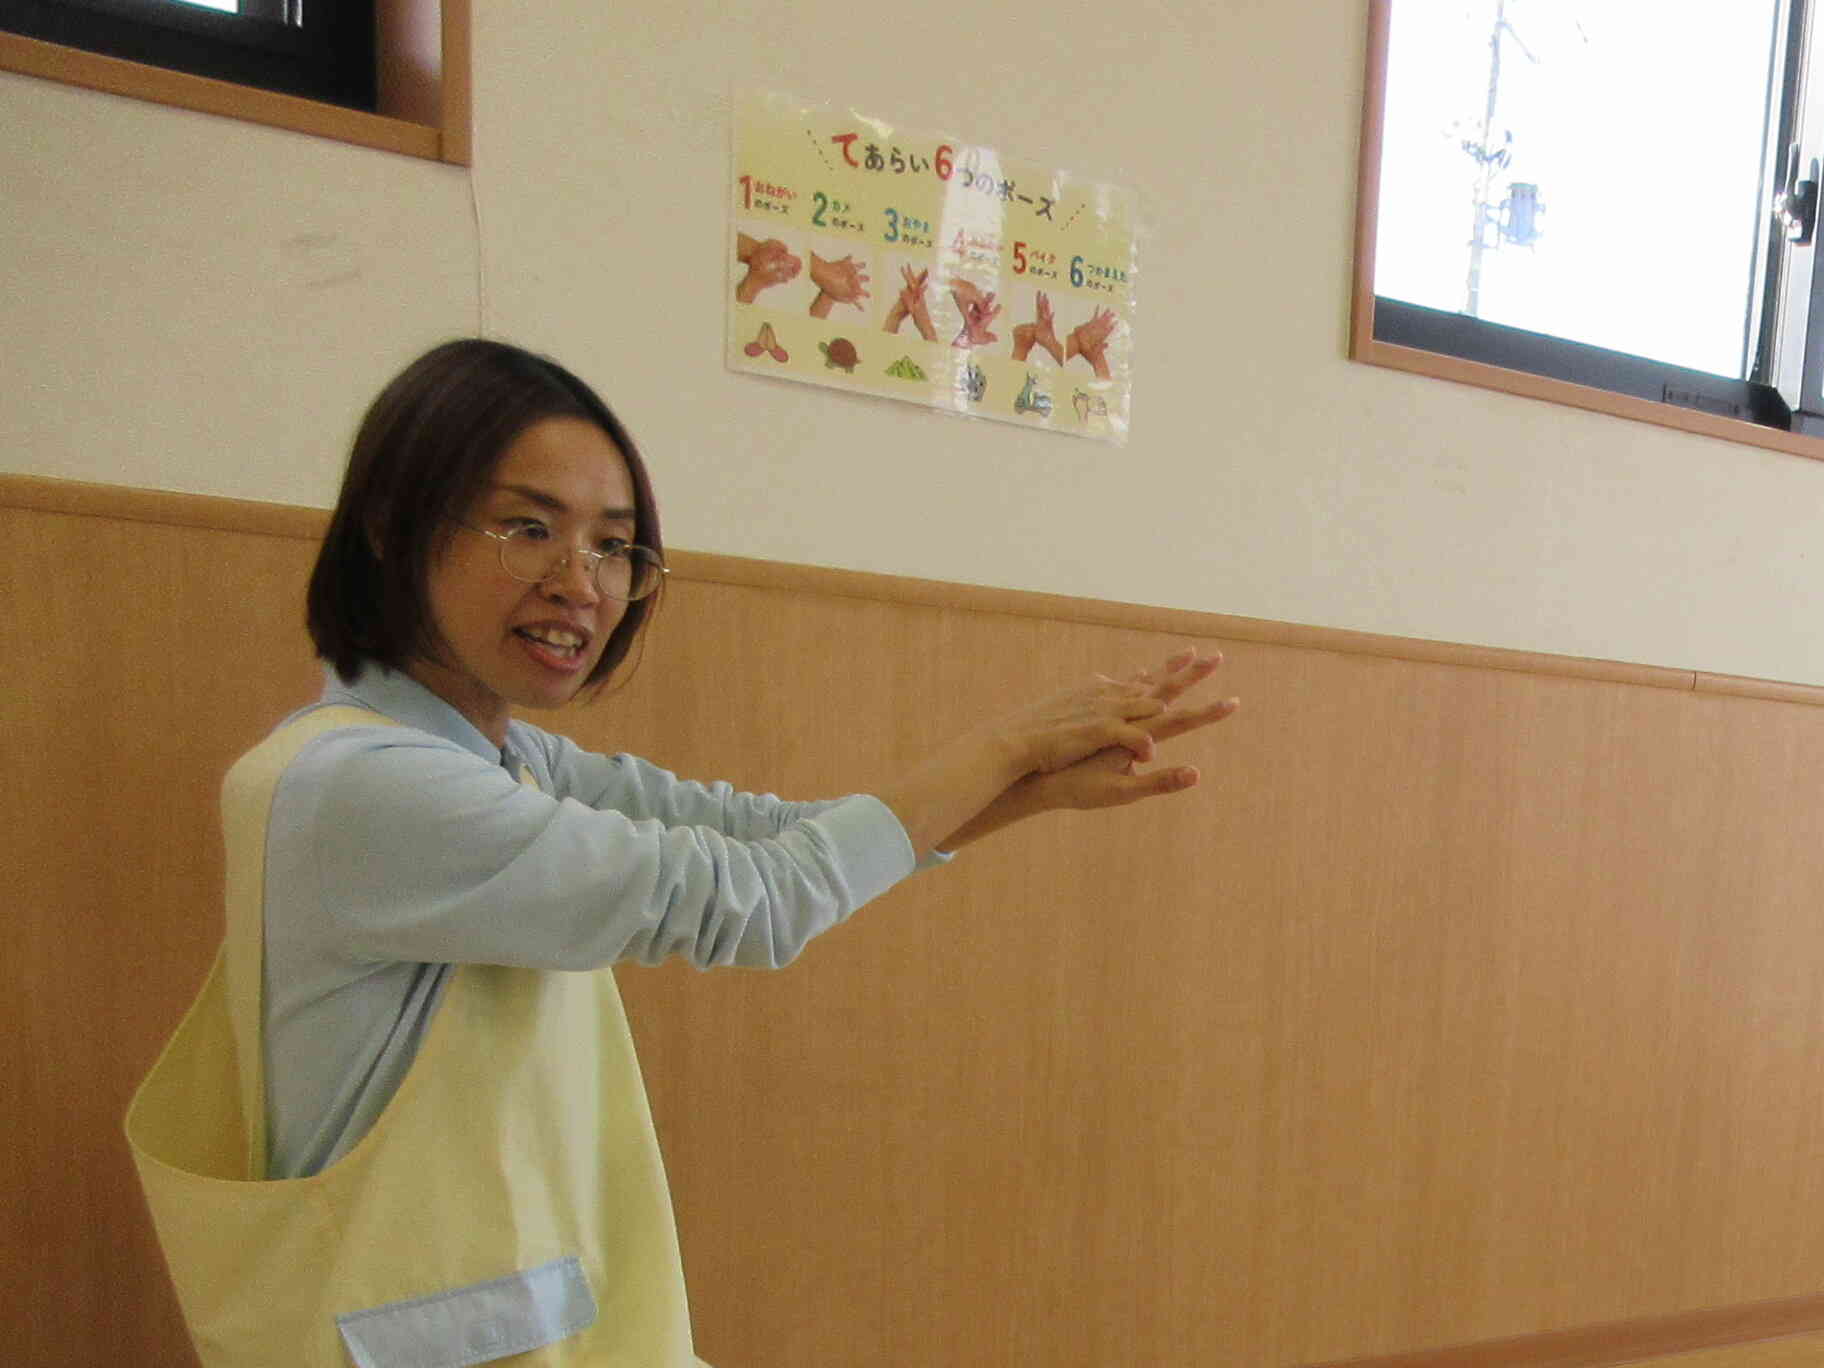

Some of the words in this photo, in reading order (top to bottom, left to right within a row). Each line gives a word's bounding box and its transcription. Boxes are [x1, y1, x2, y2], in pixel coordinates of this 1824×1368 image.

[739, 175, 752, 209] 1
[812, 191, 828, 226] 2
[884, 207, 899, 241] 3
[1012, 241, 1027, 274] 5
[1070, 255, 1084, 287] 6
